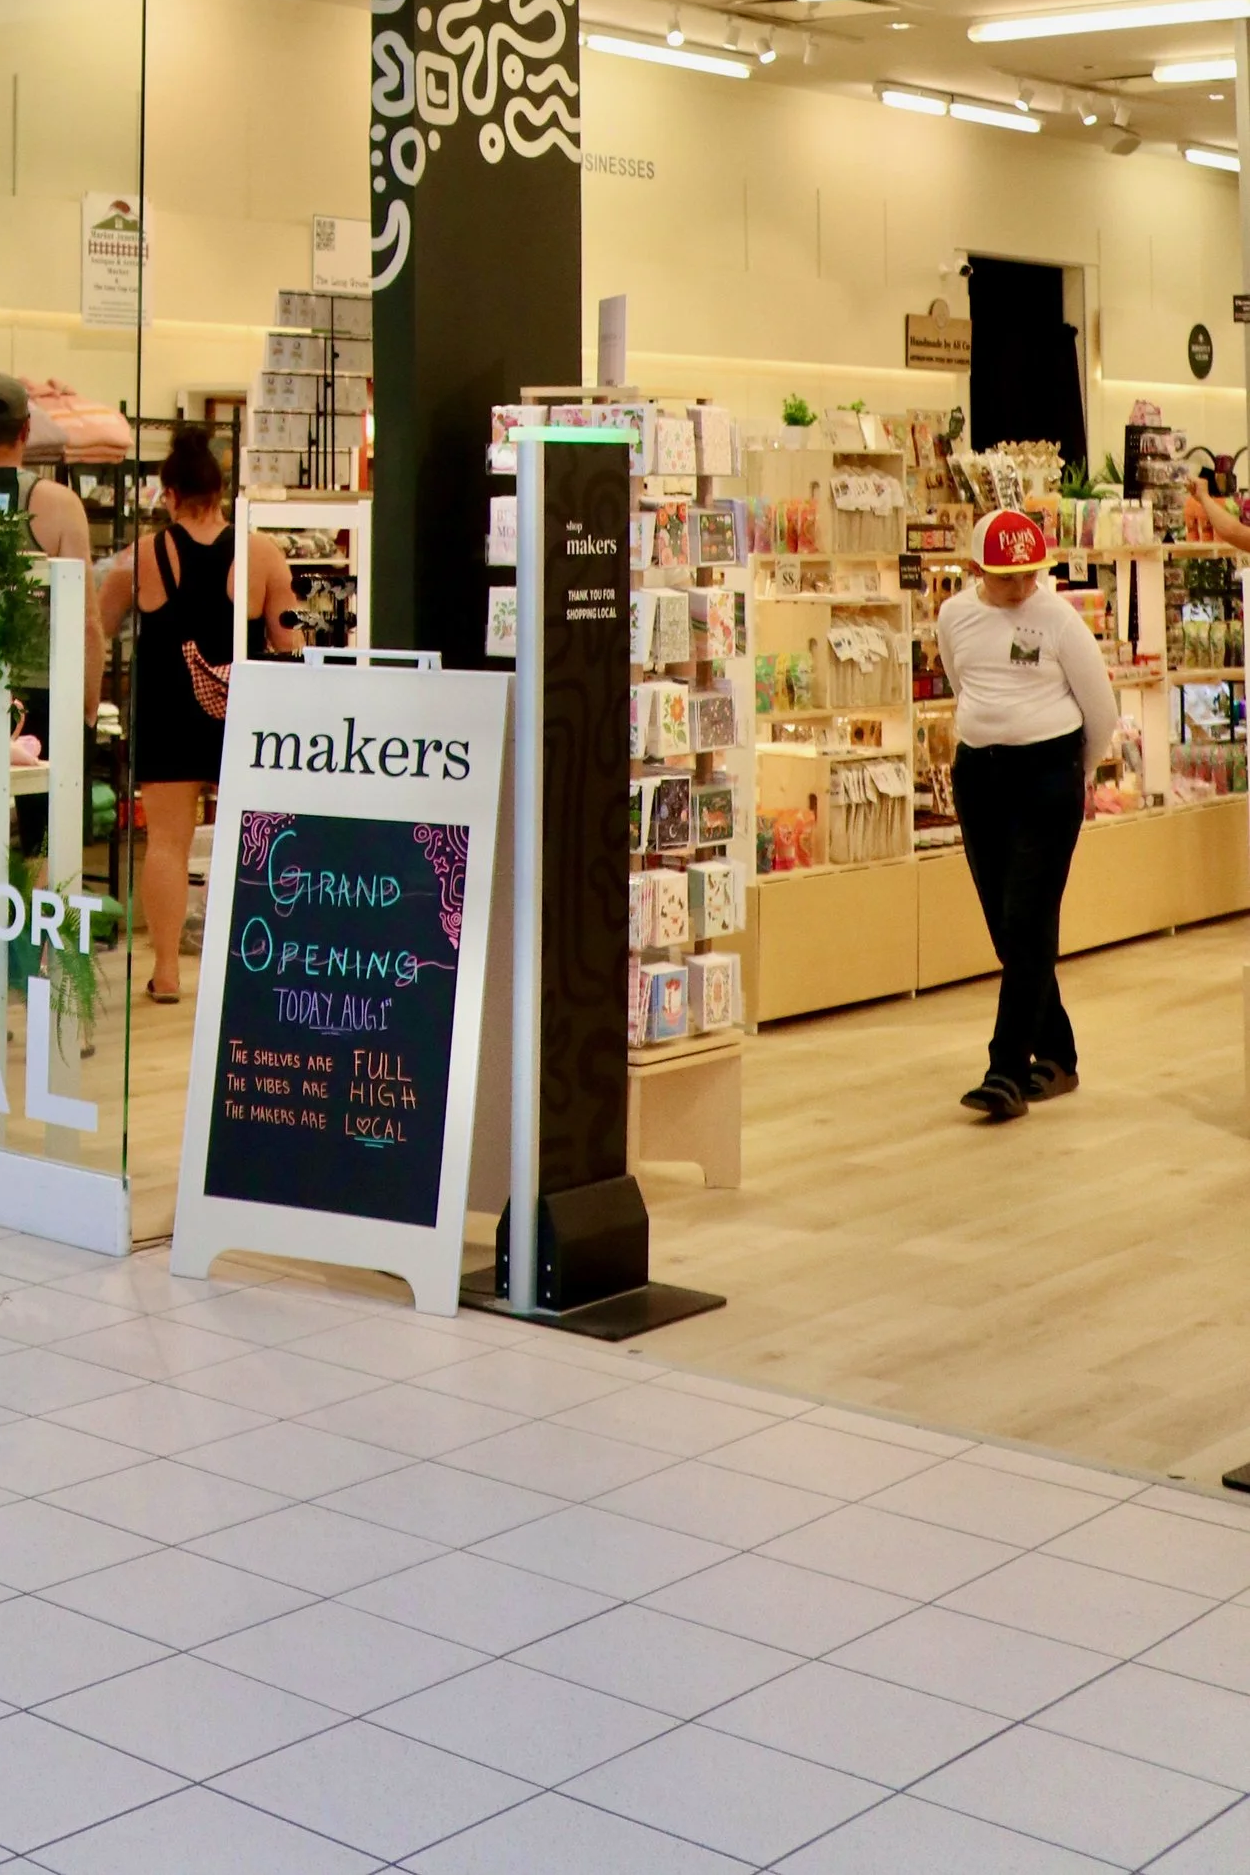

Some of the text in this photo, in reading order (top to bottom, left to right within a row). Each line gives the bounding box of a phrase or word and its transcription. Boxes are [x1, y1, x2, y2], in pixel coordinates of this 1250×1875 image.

[566, 533, 618, 556] makers
[568, 587, 616, 602] THANK YOU FOR
[566, 606, 617, 621] SHOPPING LOCAL
[249, 717, 471, 782] makers
[268, 830, 401, 908] GRAND
[240, 917, 418, 984] OPENING
[341, 993, 377, 1031] AUG
[229, 1039, 412, 1082] THE SHELVES ARE FULL
[227, 1073, 417, 1110] THE VIBES ARE HIGH
[224, 1099, 244, 1119] THE
[250, 1105, 296, 1127] MAKERS
[300, 1109, 327, 1131] ARE
